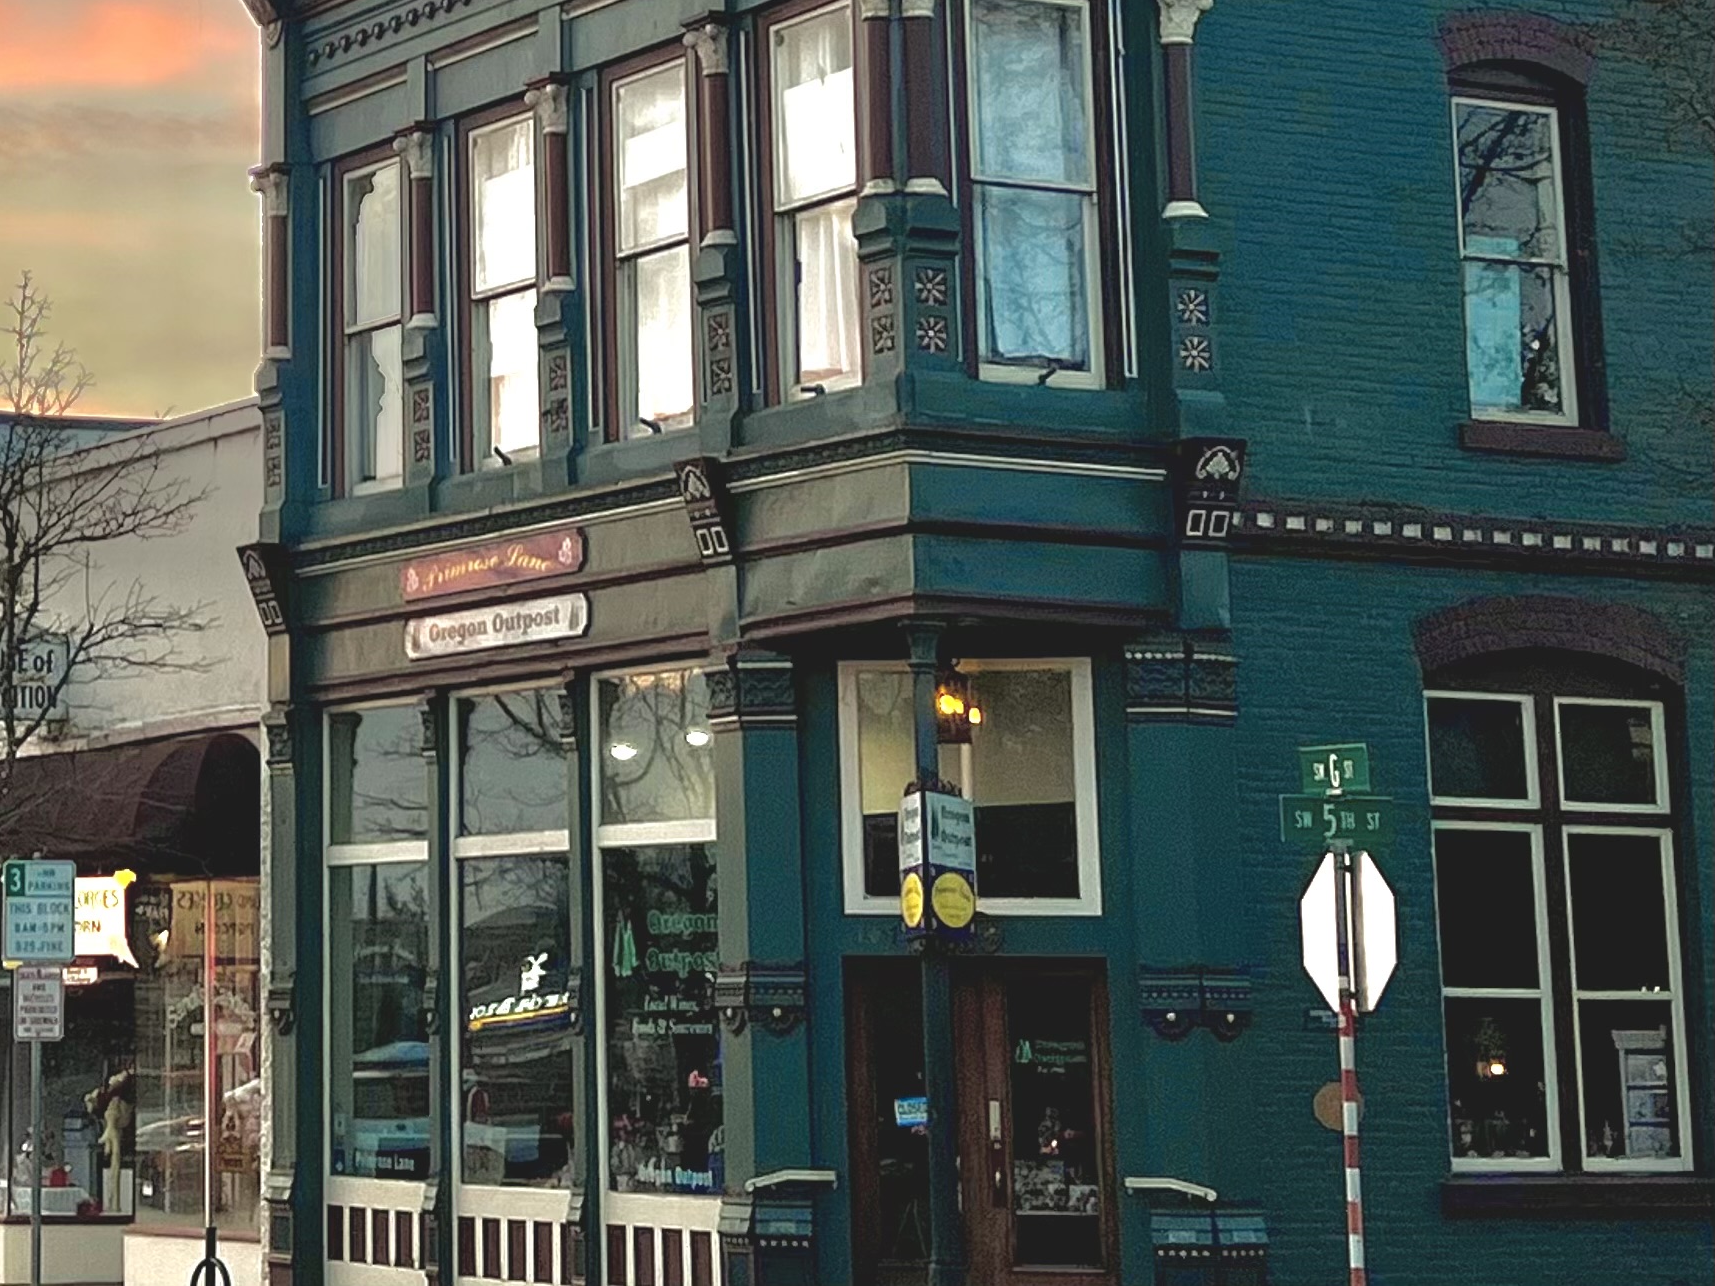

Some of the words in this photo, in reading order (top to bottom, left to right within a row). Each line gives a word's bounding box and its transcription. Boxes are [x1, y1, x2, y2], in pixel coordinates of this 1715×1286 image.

[422, 555, 500, 592] Primrose
[503, 543, 553, 572] Lane
[429, 619, 487, 644] Oregon
[492, 606, 560, 635] Outpost
[33, 649, 54, 674] of
[1329, 753, 1341, 788] G
[1294, 810, 1313, 829] SW
[1366, 812, 1381, 831] ST
[9, 867, 21, 893] 3
[27, 881, 70, 892] PARKING
[10, 902, 32, 914] THIS
[37, 901, 70, 914] BLOCK
